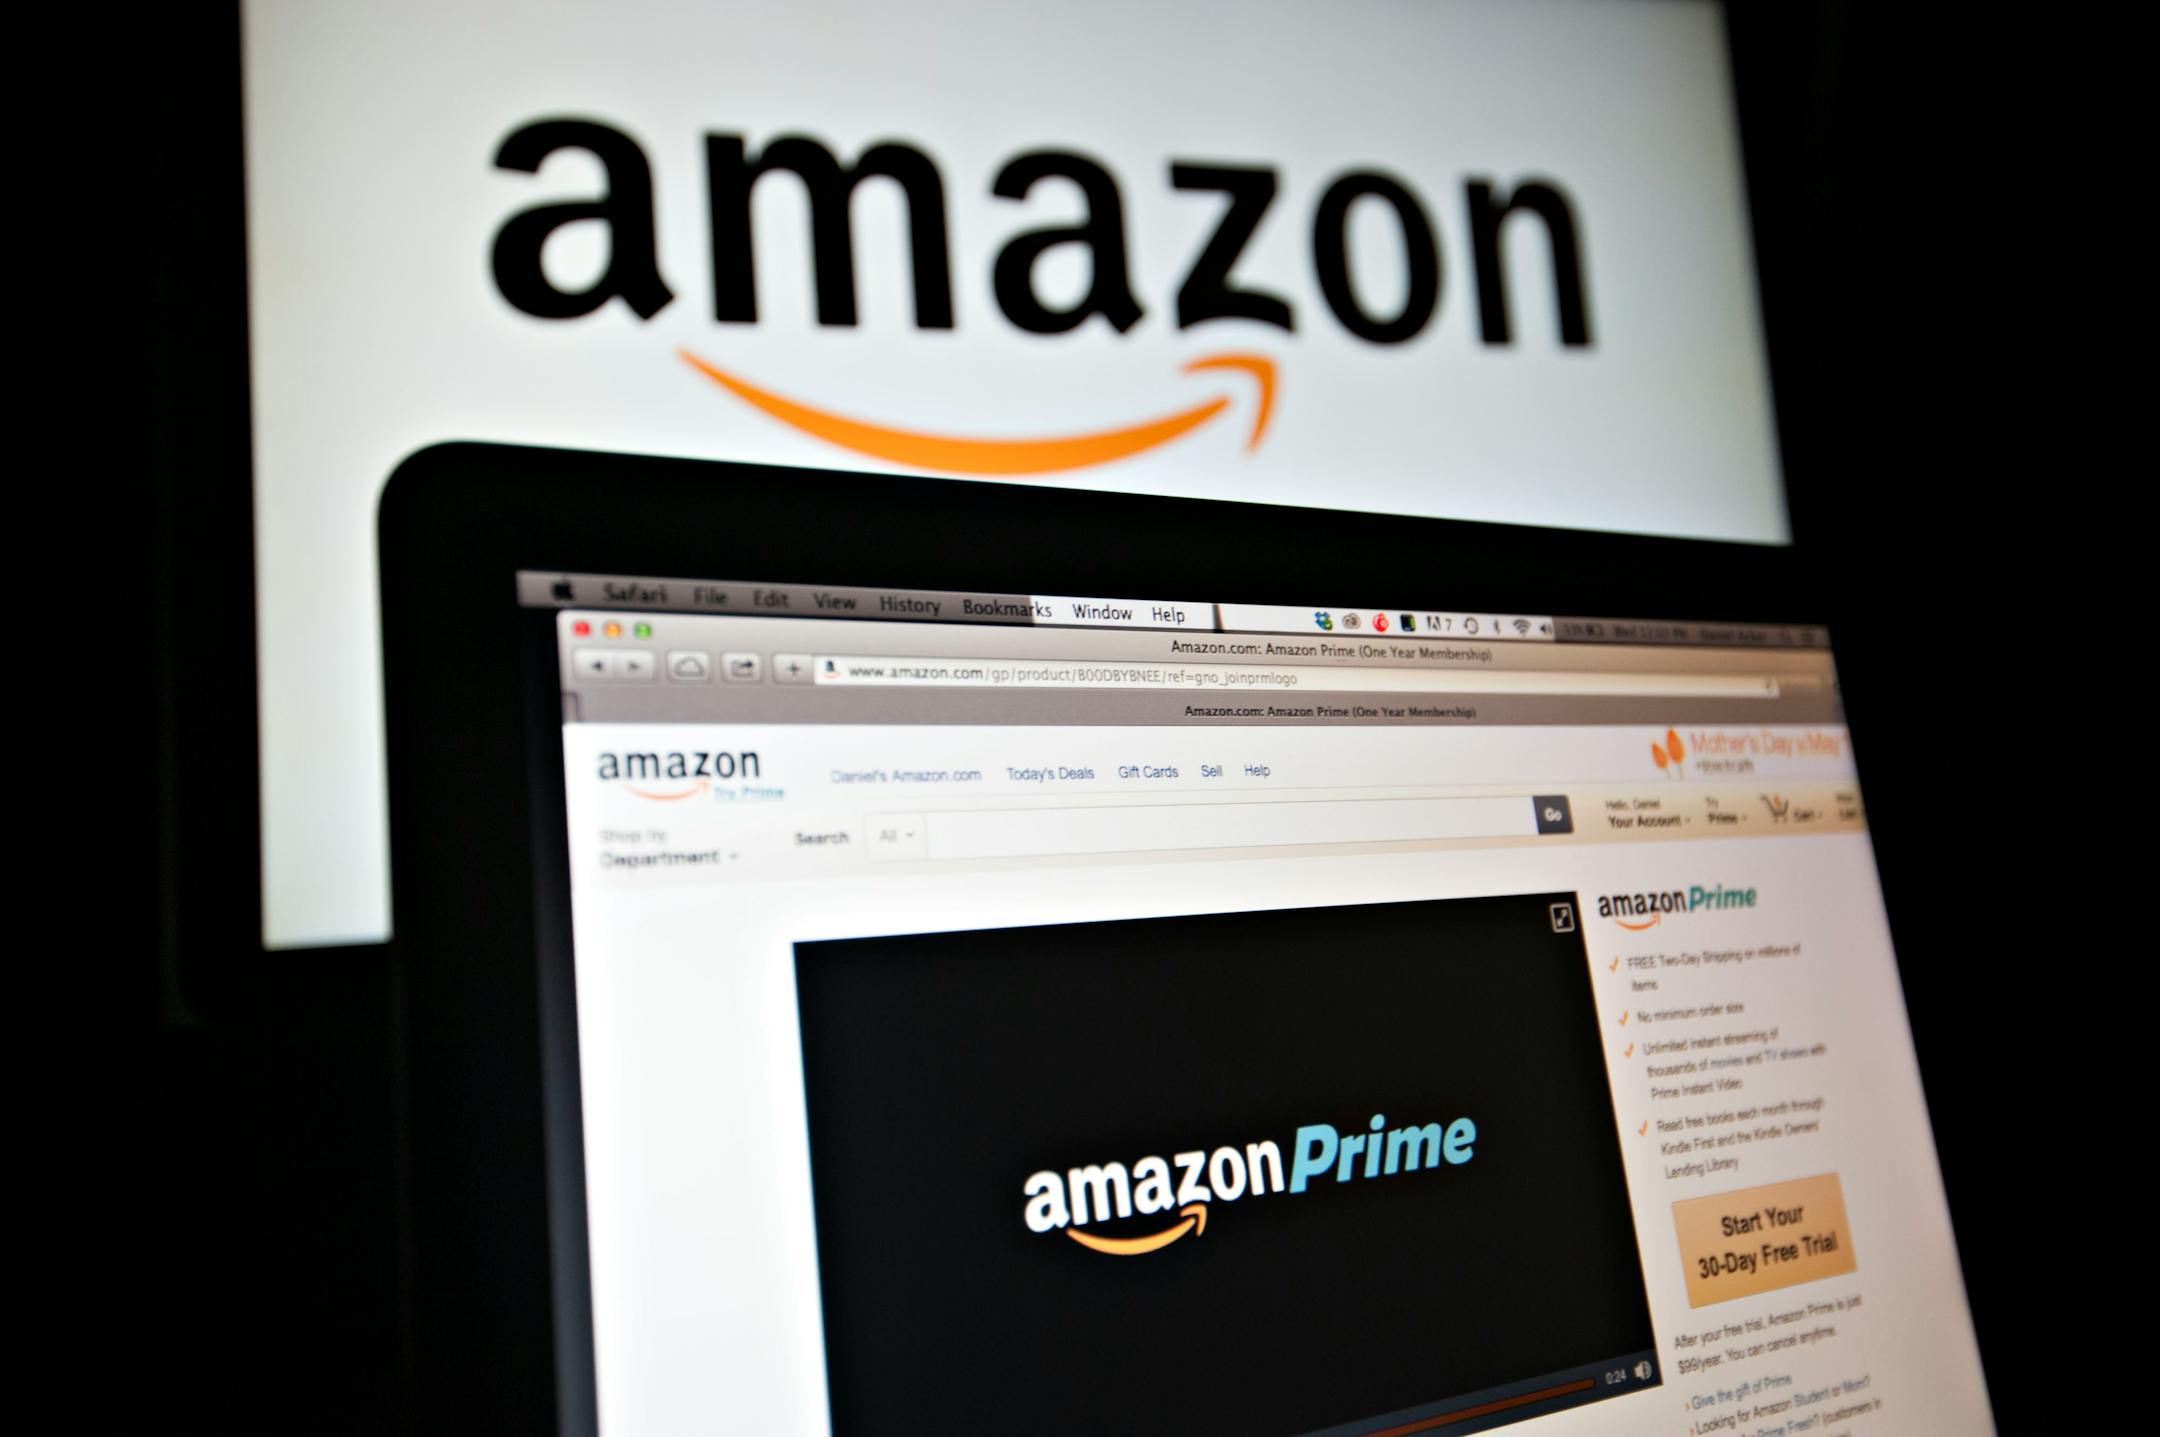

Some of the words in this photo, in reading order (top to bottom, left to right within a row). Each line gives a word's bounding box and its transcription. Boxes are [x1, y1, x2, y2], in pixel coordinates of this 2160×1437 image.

[488, 114, 1594, 349] amazon
[603, 583, 668, 602] Safari
[694, 587, 727, 604] File
[753, 590, 788, 607] Edit
[814, 593, 857, 610] View
[880, 596, 941, 617] History
[963, 599, 1052, 618] Bookmarks
[1072, 604, 1133, 621] Window
[1152, 607, 1186, 624] Help
[1171, 639, 1262, 657] Amazon.com:
[1265, 642, 1318, 657] Amazon
[1321, 643, 1356, 658] Prime
[1358, 644, 1388, 660] (One
[1391, 646, 1416, 660] Year
[1419, 646, 1493, 663] Membership)
[1185, 705, 1264, 718] Amazon.com:
[1267, 706, 1314, 718] Amazon
[1316, 706, 1349, 718] Prime
[1352, 706, 1380, 720] (One
[1382, 706, 1405, 719] Year
[1408, 706, 1477, 720] Membership)
[1762, 730, 1793, 758] Day
[597, 750, 761, 780] amazon
[1118, 765, 1142, 780] Gift
[1143, 764, 1179, 779] Cards
[1201, 764, 1223, 778] Sell
[1244, 763, 1271, 780] Help
[831, 769, 888, 784] Daniel's
[892, 768, 982, 783] Amazon.com
[1007, 766, 1055, 784] Today's
[1059, 766, 1096, 781] Deals
[1543, 807, 1563, 823] Go
[1608, 814, 1633, 829] Your
[1637, 813, 1682, 828] Account
[795, 831, 849, 847] Search
[601, 850, 719, 868] Department
[1627, 953, 1657, 969] FREE
[1651, 1084, 1680, 1100] Prime
[1715, 1077, 1743, 1092] Video
[1656, 1118, 1684, 1133] Read
[1660, 1139, 1691, 1156] Kindle
[1665, 1161, 1704, 1180] Lending
[1705, 1156, 1739, 1175] Library
[1721, 1212, 1763, 1238] Start
[1764, 1206, 1804, 1228] Your
[1698, 1249, 1758, 1280] 30-Day
[1761, 1241, 1799, 1267] Free
[1802, 1231, 1838, 1257] Trial
[1674, 1333, 1699, 1350] After
[1700, 1328, 1723, 1347] your
[1724, 1323, 1744, 1340] free
[1768, 1307, 1807, 1329] Amazon
[1808, 1300, 1835, 1320] Prime
[1725, 1345, 1746, 1363] You
[1604, 1368, 1627, 1386] 0:24
[1692, 1395, 1715, 1410] Give
[1717, 1389, 1733, 1405] the
[1764, 1374, 1793, 1391] Prime
[1695, 1413, 1737, 1436] Looking
[1737, 1408, 1752, 1424] for
[1753, 1399, 1793, 1420] Amazon
